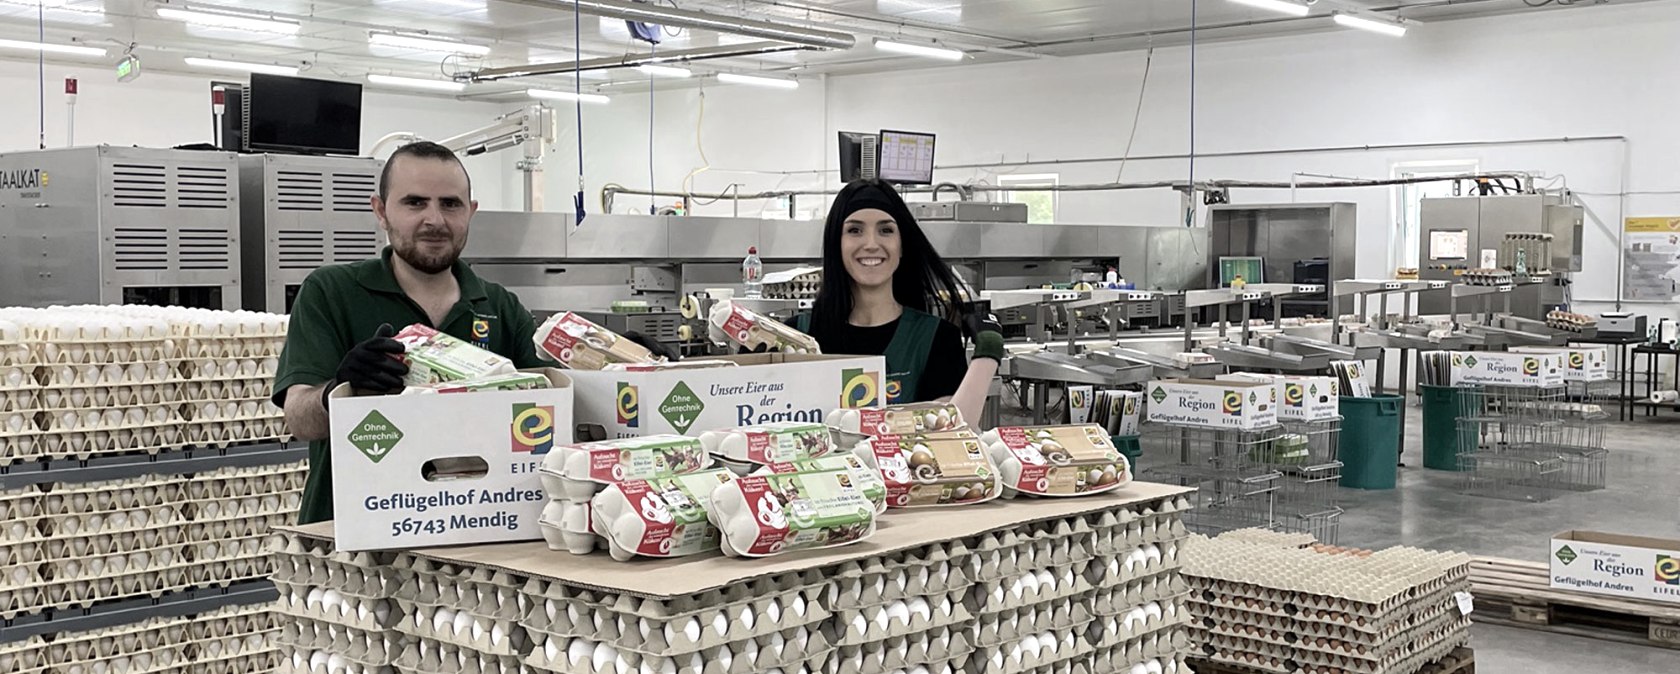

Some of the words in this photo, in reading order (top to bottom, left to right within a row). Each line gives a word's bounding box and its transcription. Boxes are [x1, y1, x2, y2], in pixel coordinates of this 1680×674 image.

[709, 384, 743, 396] Unsere
[745, 382, 767, 394] Eier
[768, 383, 784, 392] aus
[672, 395, 691, 404] Ohne
[759, 395, 776, 407] der
[1179, 397, 1216, 412] Region
[1150, 413, 1186, 422] Geflügelhof
[1187, 416, 1209, 424] Andres
[1222, 418, 1243, 426] EIFEL
[363, 423, 387, 432] Ohne
[511, 462, 543, 474] EIF
[364, 489, 475, 513] Geflügelhof
[479, 487, 543, 505] Andres
[391, 518, 446, 537] 56743
[450, 511, 519, 530] Mendig
[1593, 558, 1644, 577] Region
[1554, 575, 1602, 588] Geflügelhof
[1604, 581, 1634, 592] Andres
[1653, 586, 1680, 596] EIFEL
